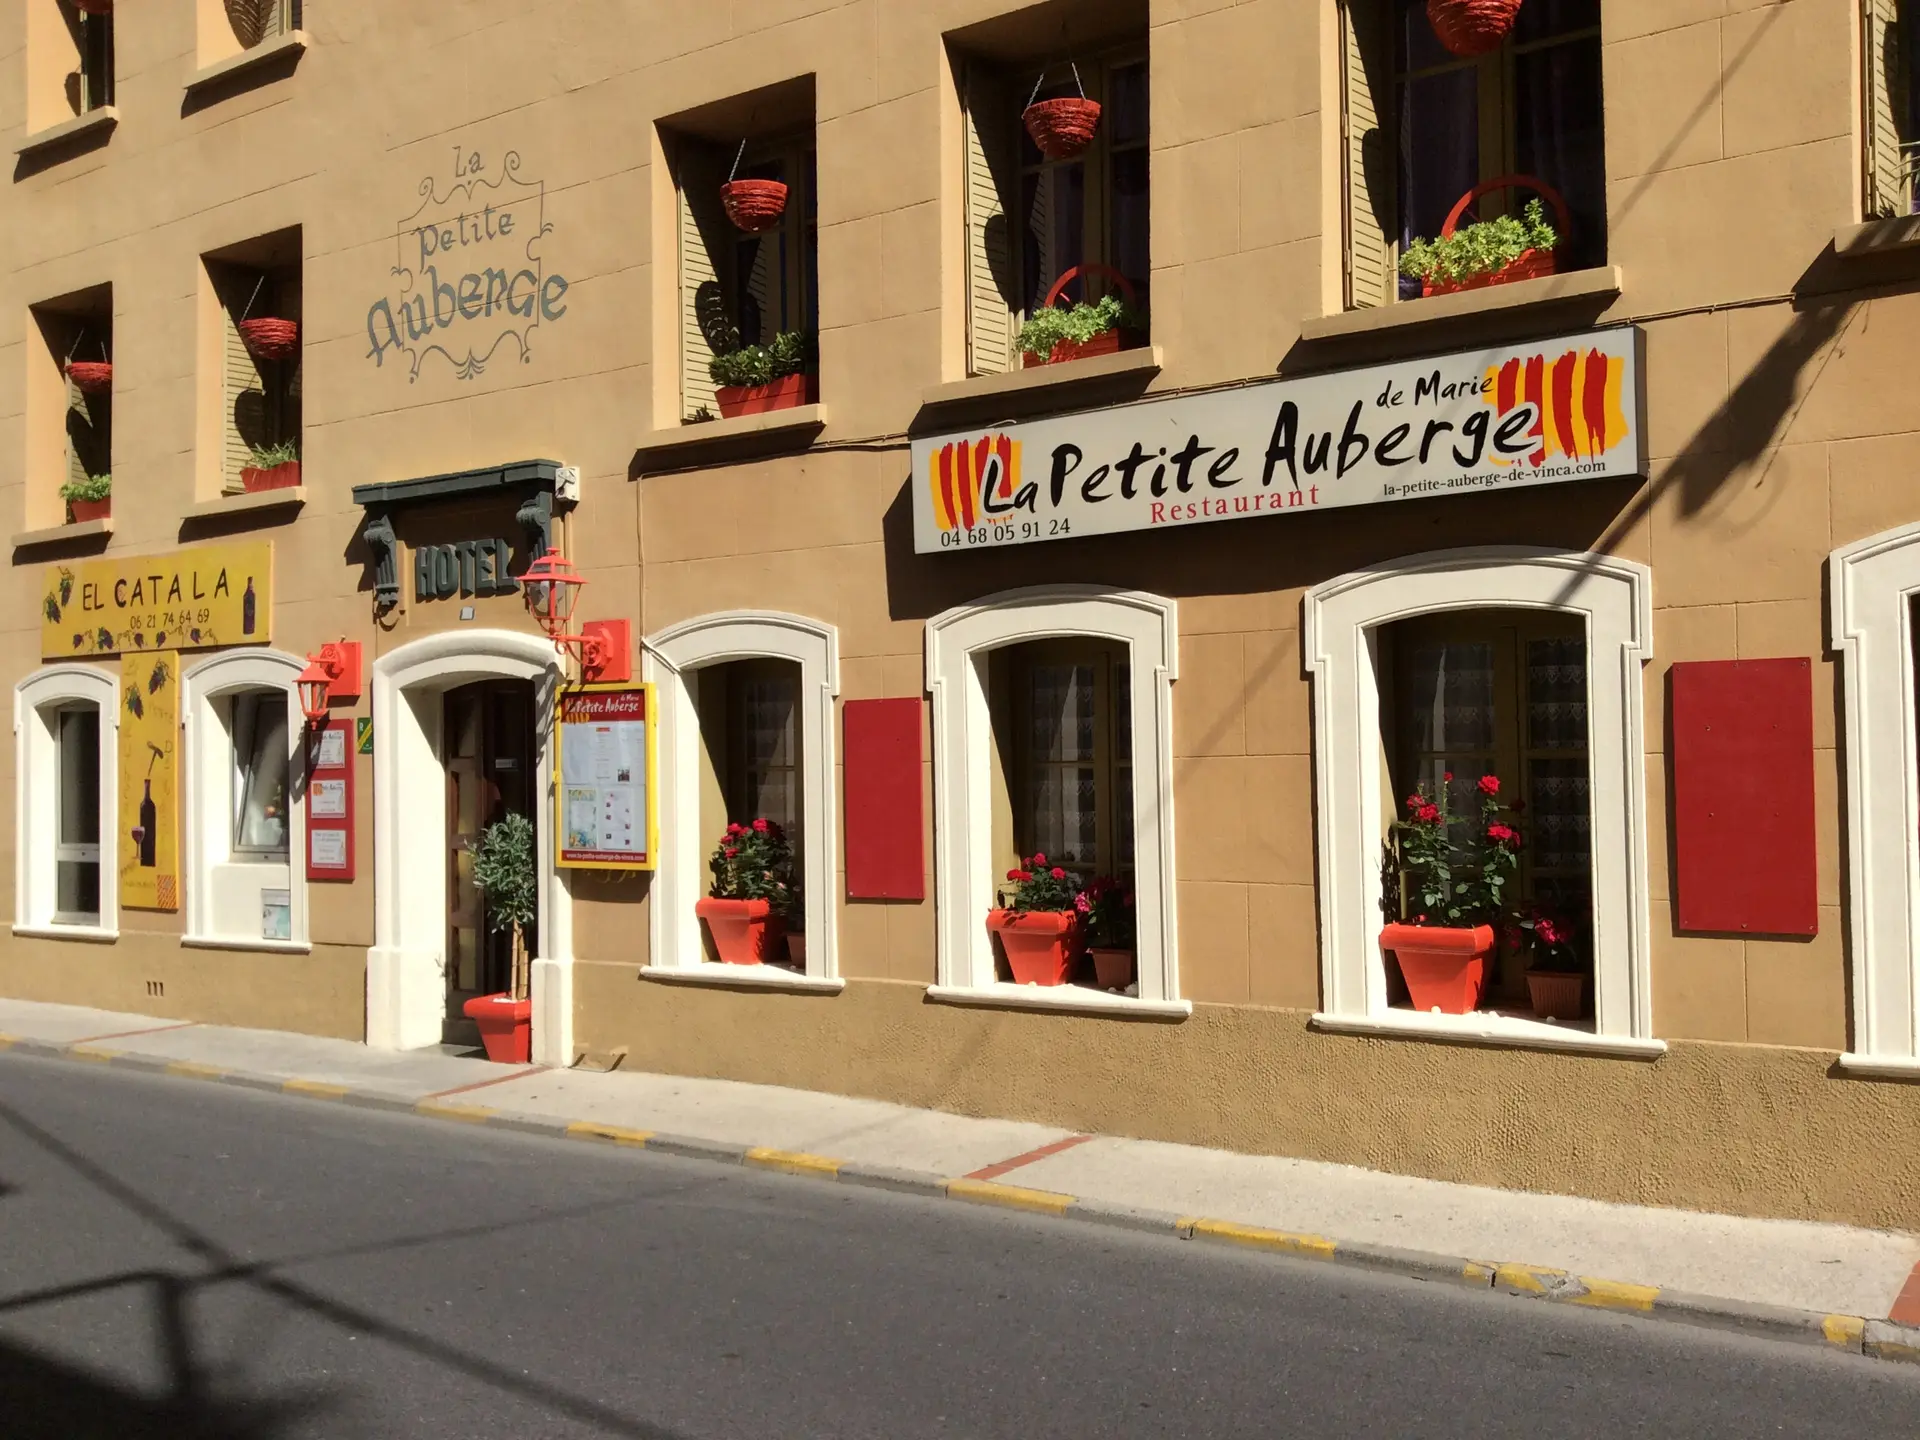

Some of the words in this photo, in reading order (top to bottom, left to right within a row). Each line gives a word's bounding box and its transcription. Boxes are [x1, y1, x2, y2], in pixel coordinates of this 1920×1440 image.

[452, 146, 484, 177] La
[1376, 380, 1404, 408] de
[1414, 370, 1494, 406] Marie
[983, 455, 1039, 514] La
[1050, 434, 1243, 508] Petite
[1262, 400, 1537, 490] Auberge
[1383, 461, 1607, 496] la-petite-auberge-de-vinca.com
[1150, 484, 1319, 524] Restaurant
[941, 530, 961, 547] 04
[968, 528, 987, 544] 68
[994, 525, 1015, 541] 05
[1022, 522, 1040, 538] 91
[1049, 518, 1070, 535] 24
[415, 539, 519, 602] HOTEL
[82, 583, 104, 611] EL
[114, 567, 229, 608] CATALA
[130, 615, 142, 629] 06
[147, 614, 156, 628] 21
[163, 612, 174, 626] 74
[179, 610, 191, 624] 64
[197, 608, 210, 623] 69
[605, 697, 639, 713] Auberge
